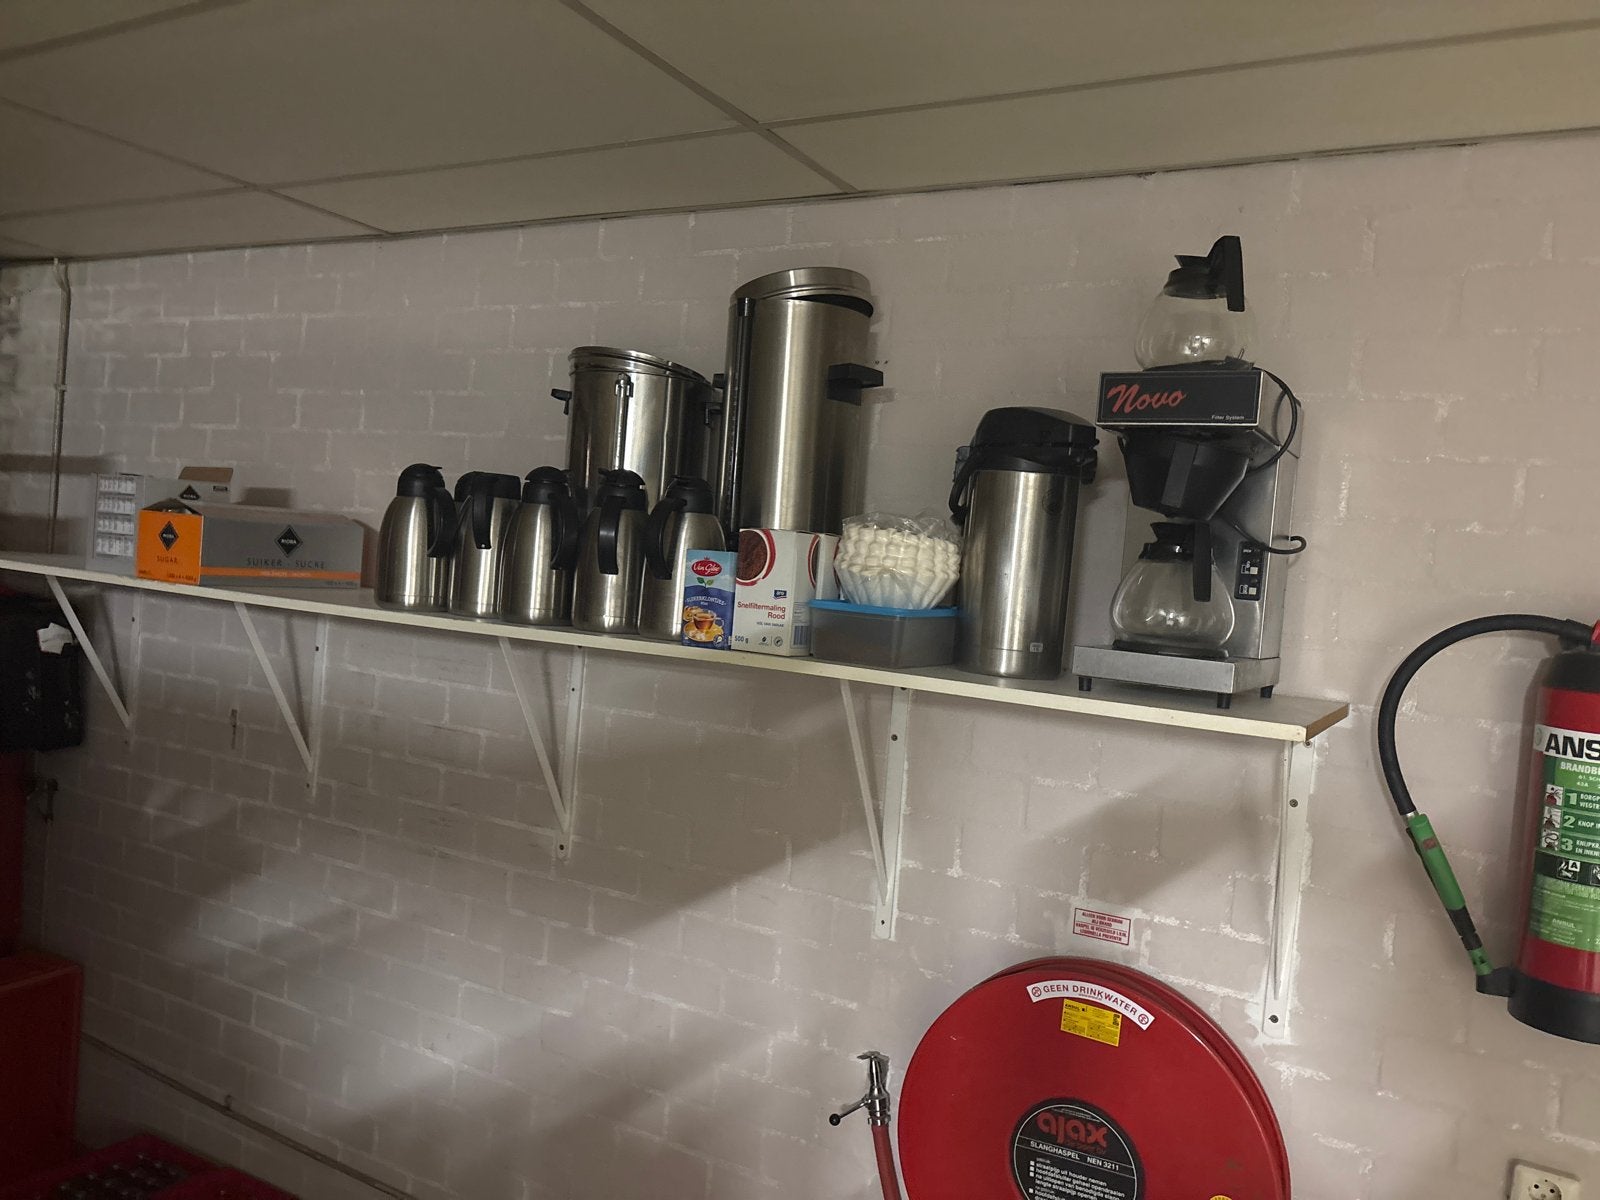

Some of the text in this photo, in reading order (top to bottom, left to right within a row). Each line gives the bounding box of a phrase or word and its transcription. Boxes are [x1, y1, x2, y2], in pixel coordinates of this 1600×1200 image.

[1106, 383, 1187, 414] Novo
[156, 555, 178, 564] SUGAR
[246, 557, 282, 568] SUIKER
[693, 563, 705, 571] Van
[737, 601, 786, 613] Snelfiltermaling
[767, 611, 786, 620] Rood
[1560, 761, 1600, 776] BRANDB
[1566, 792, 1577, 805] 1
[1563, 815, 1576, 829] 2
[1577, 820, 1595, 828] KNOP
[1561, 837, 1574, 852] 3
[1043, 984, 1069, 993] GEEN
[1072, 985, 1138, 1016] DRINKWATER
[1037, 1112, 1108, 1148] ajax
[1030, 1140, 1080, 1160] SLANGHASPEL
[1087, 1156, 1102, 1167] NEN
[1103, 1161, 1119, 1171] 3211
[1068, 1171, 1087, 1180] houder
[1088, 1177, 1107, 1187] nemen
